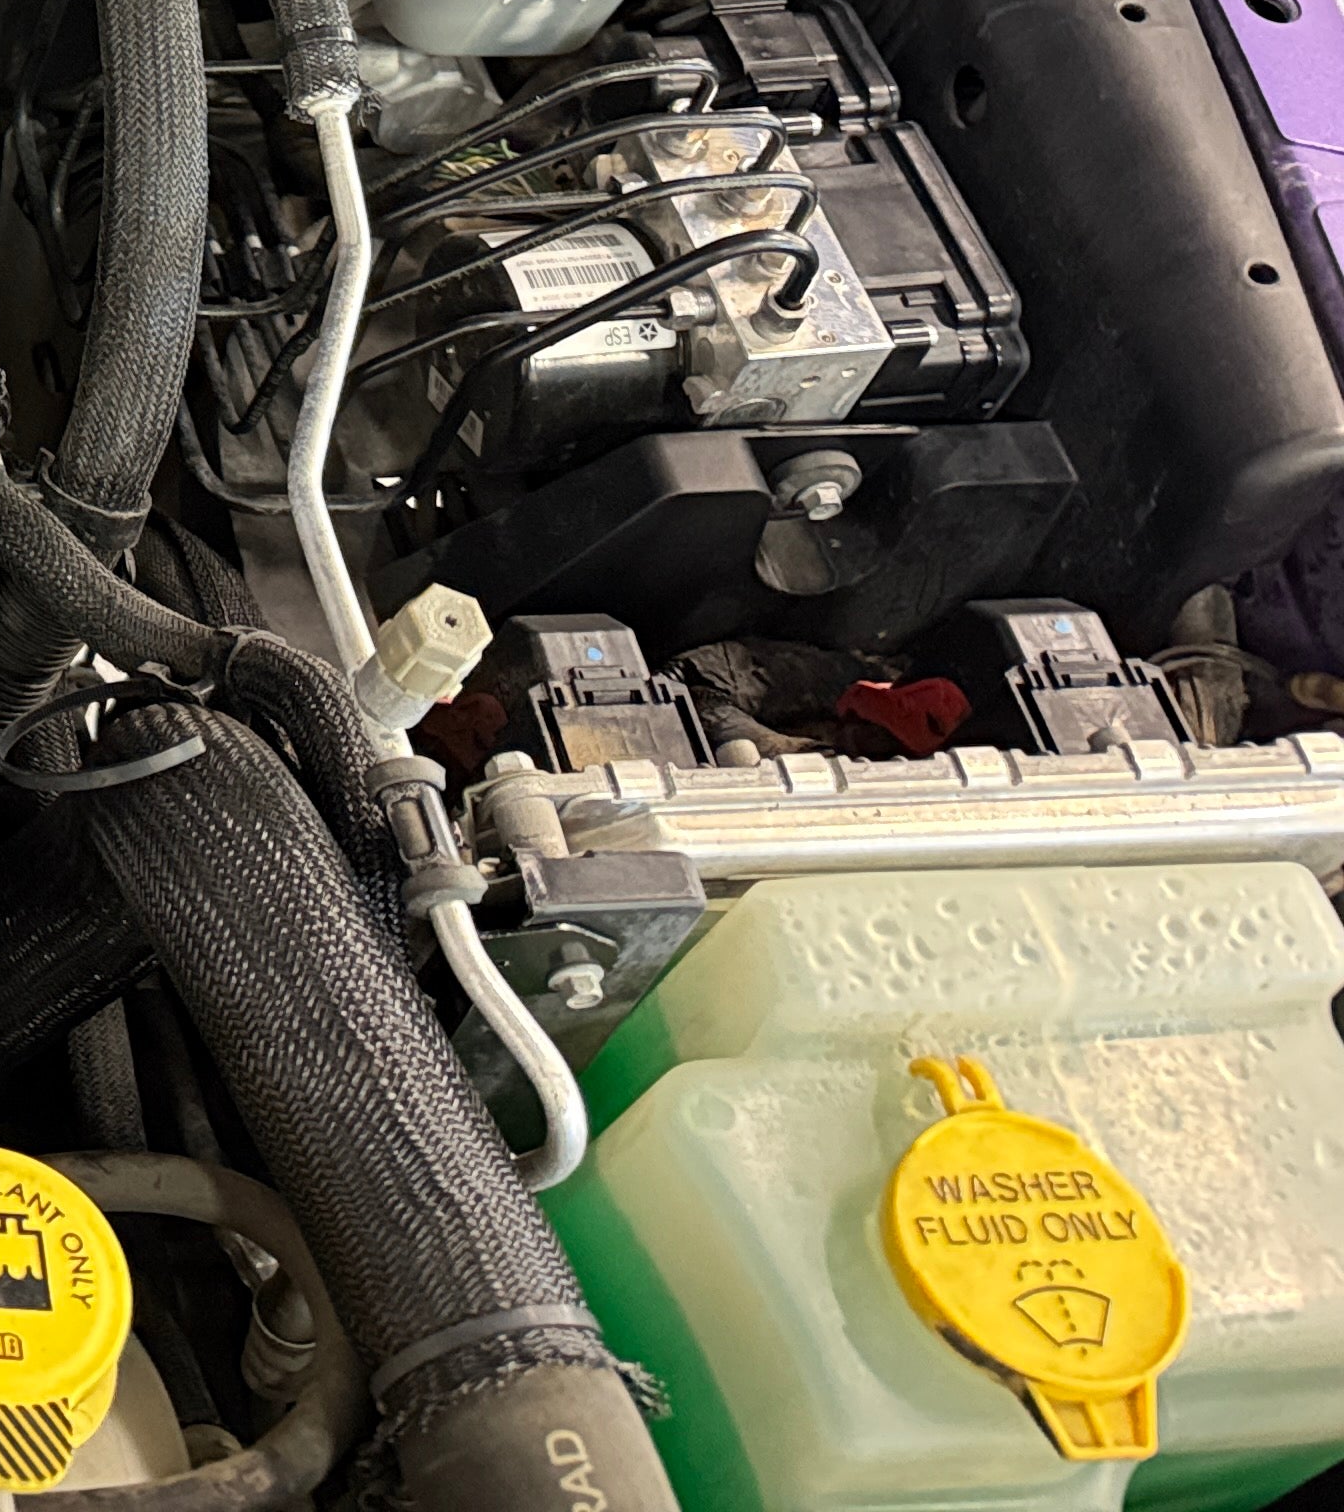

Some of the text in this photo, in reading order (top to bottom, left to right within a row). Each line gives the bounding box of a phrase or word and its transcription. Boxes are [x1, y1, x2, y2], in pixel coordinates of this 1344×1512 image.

[604, 326, 632, 346] ESP
[924, 1168, 1102, 1207] WASHER
[916, 1208, 1141, 1249] FLUID ONLY
[61, 1232, 95, 1311] ONLY
